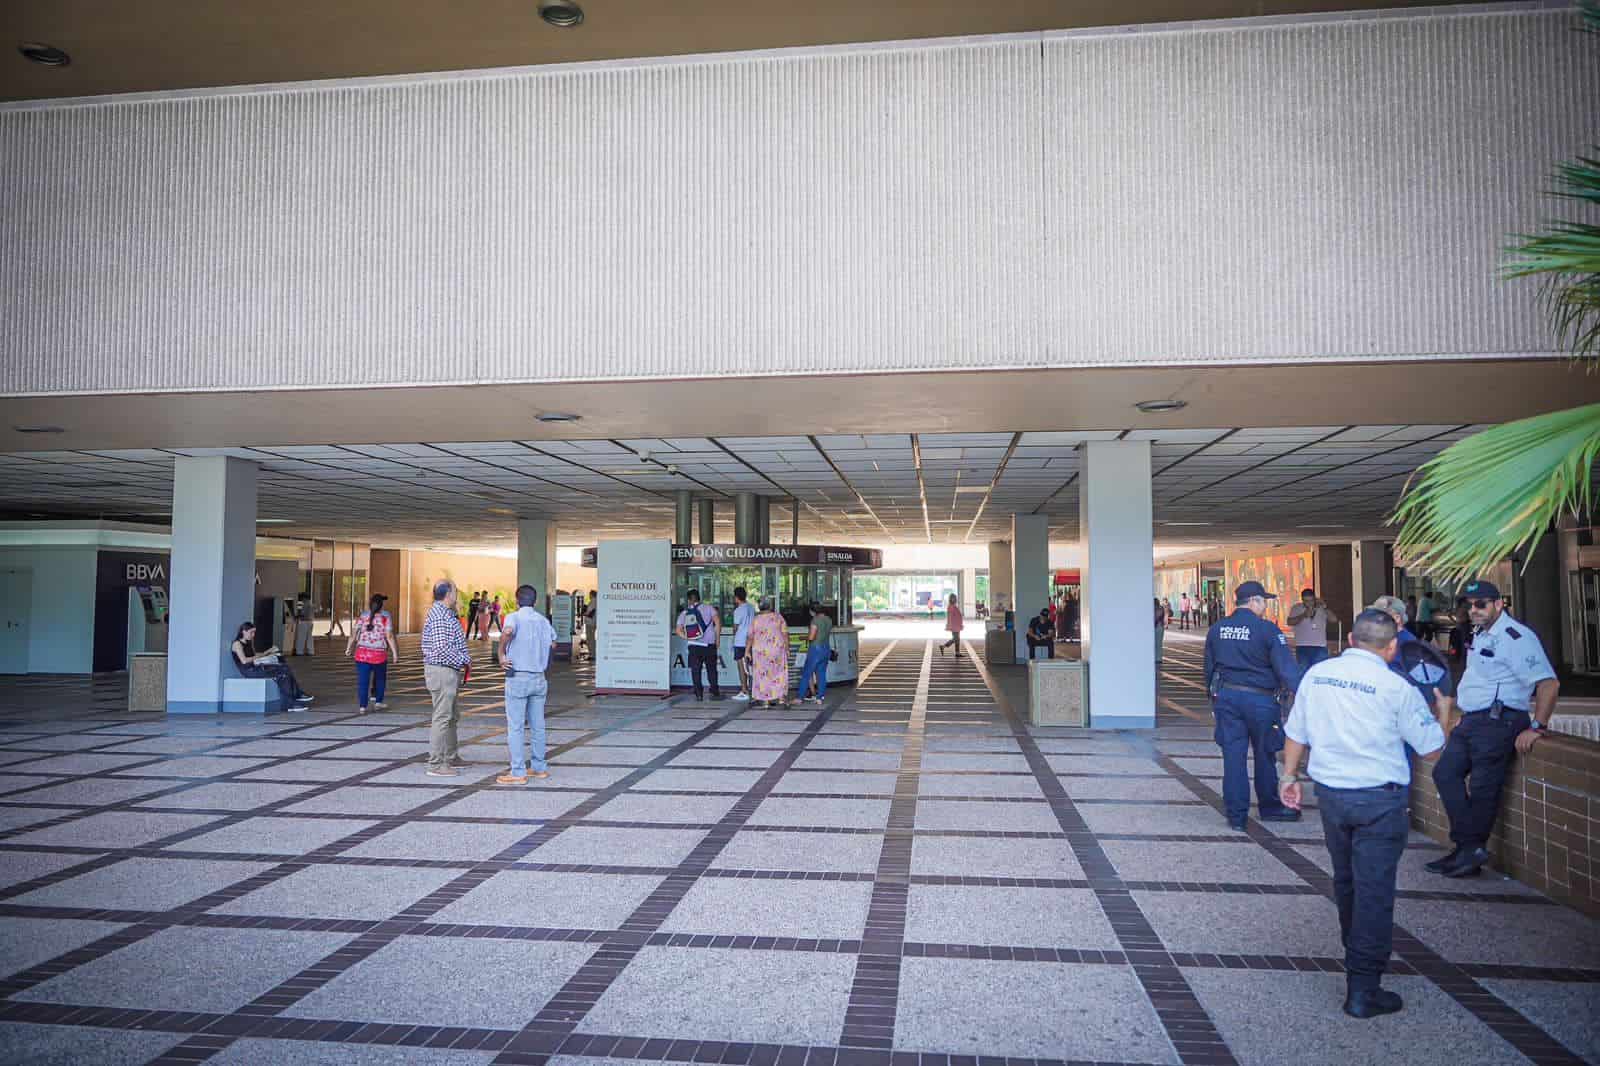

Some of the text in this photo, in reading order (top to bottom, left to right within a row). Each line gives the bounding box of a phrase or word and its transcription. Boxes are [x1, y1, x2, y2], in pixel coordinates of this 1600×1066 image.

[671, 546, 799, 560] TENCIÓN CIUDADANA
[126, 563, 166, 580] BBVA
[610, 582, 645, 591] CENTRO
[1220, 625, 1250, 635] POLICÍA
[1220, 633, 1250, 641] ESTATAL
